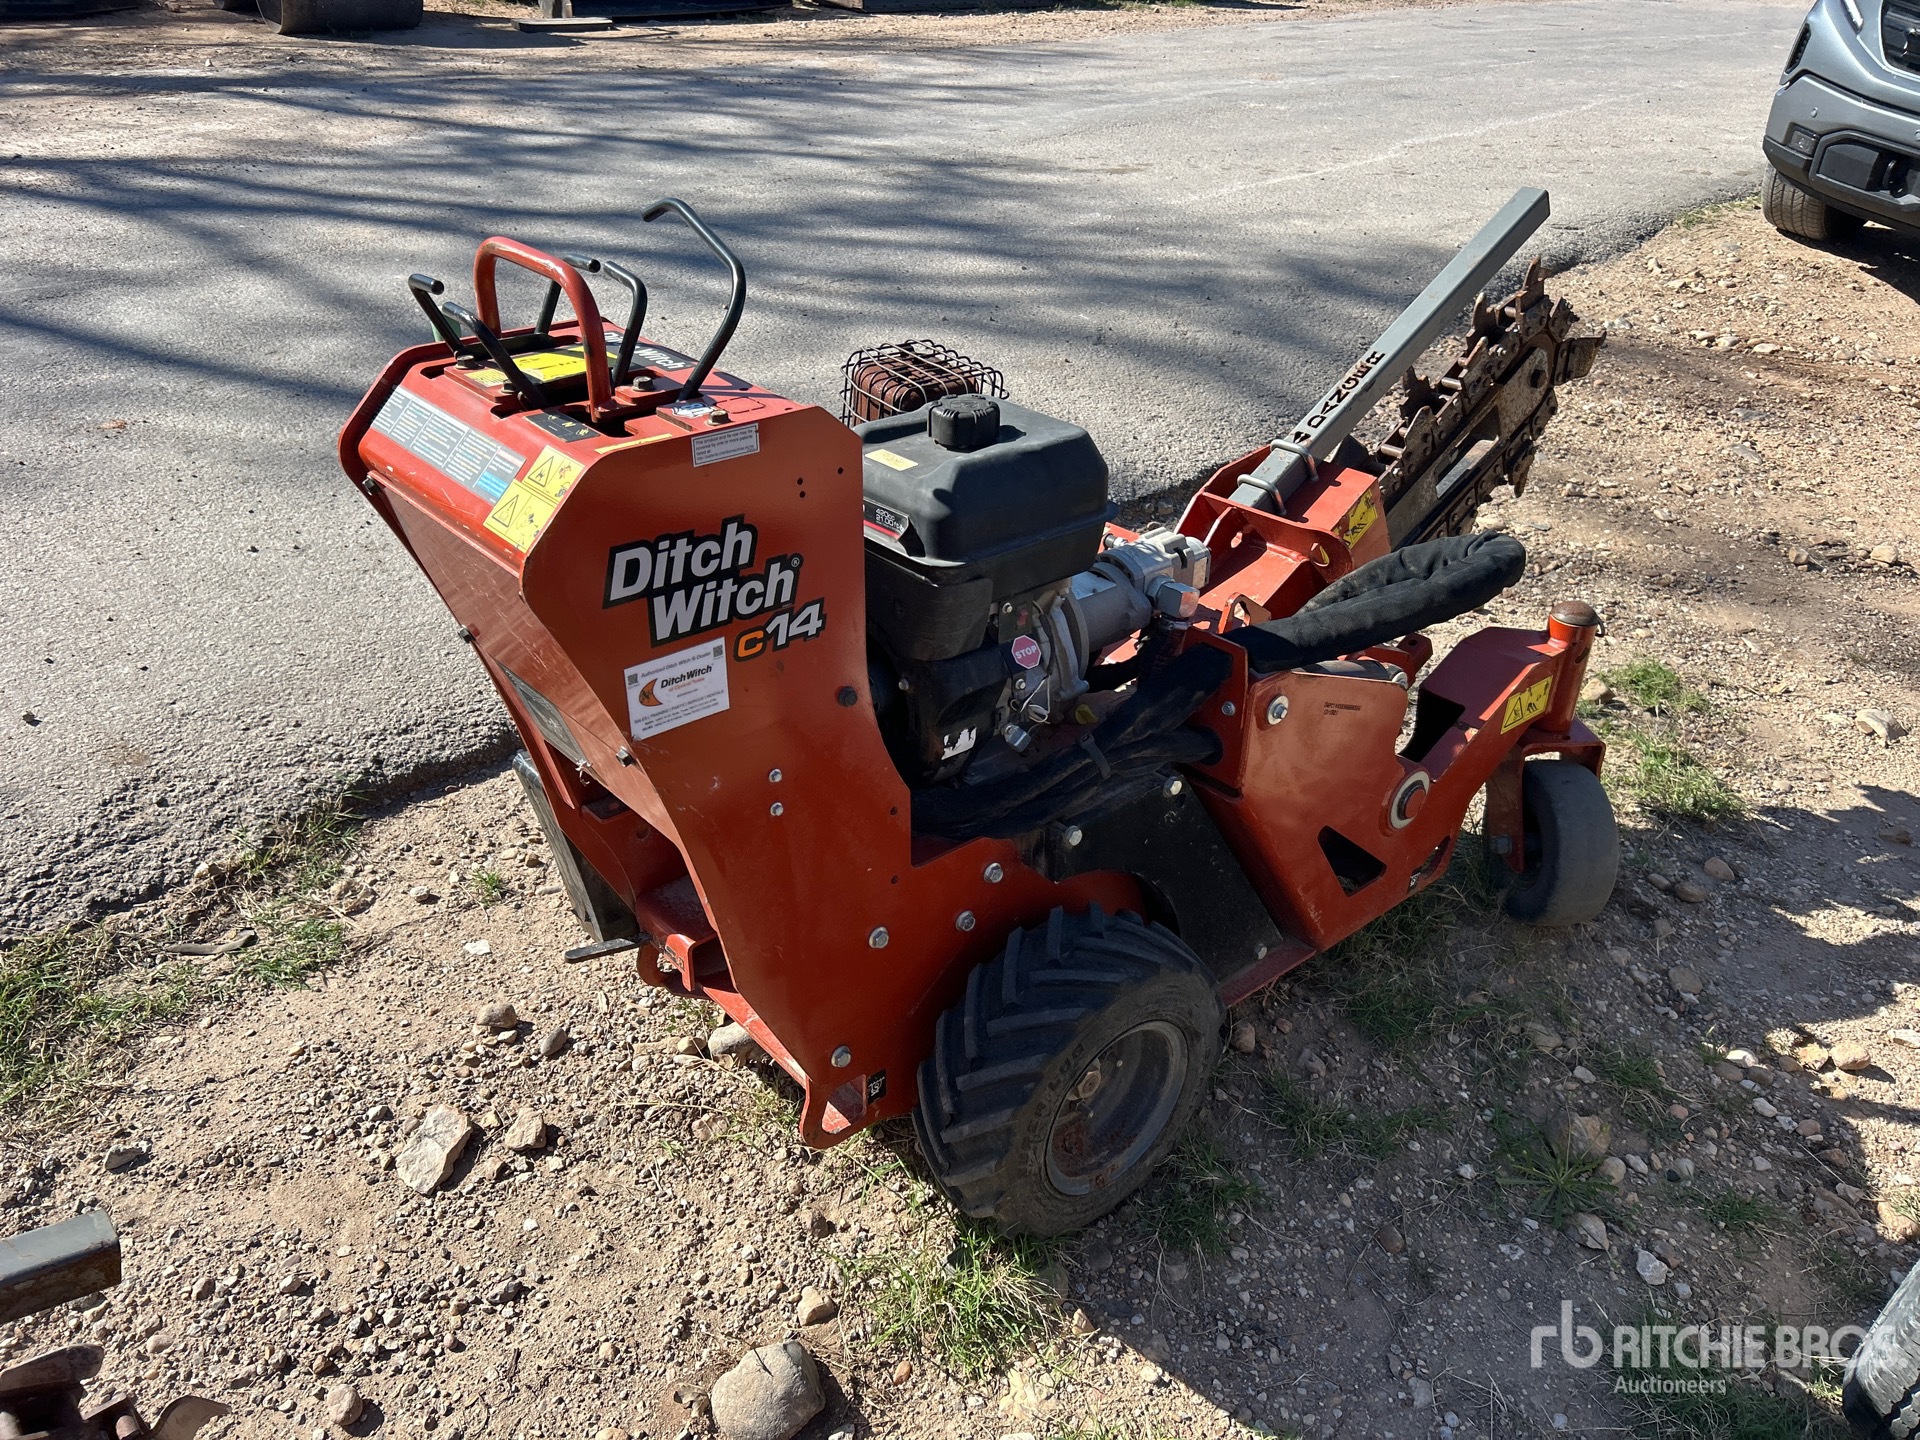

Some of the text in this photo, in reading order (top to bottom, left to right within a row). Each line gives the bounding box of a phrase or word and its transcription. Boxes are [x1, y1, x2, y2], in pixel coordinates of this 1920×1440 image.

[1307, 351, 1386, 429] DANGER
[609, 521, 753, 601] Ditch
[1015, 645, 1037, 659] STOP
